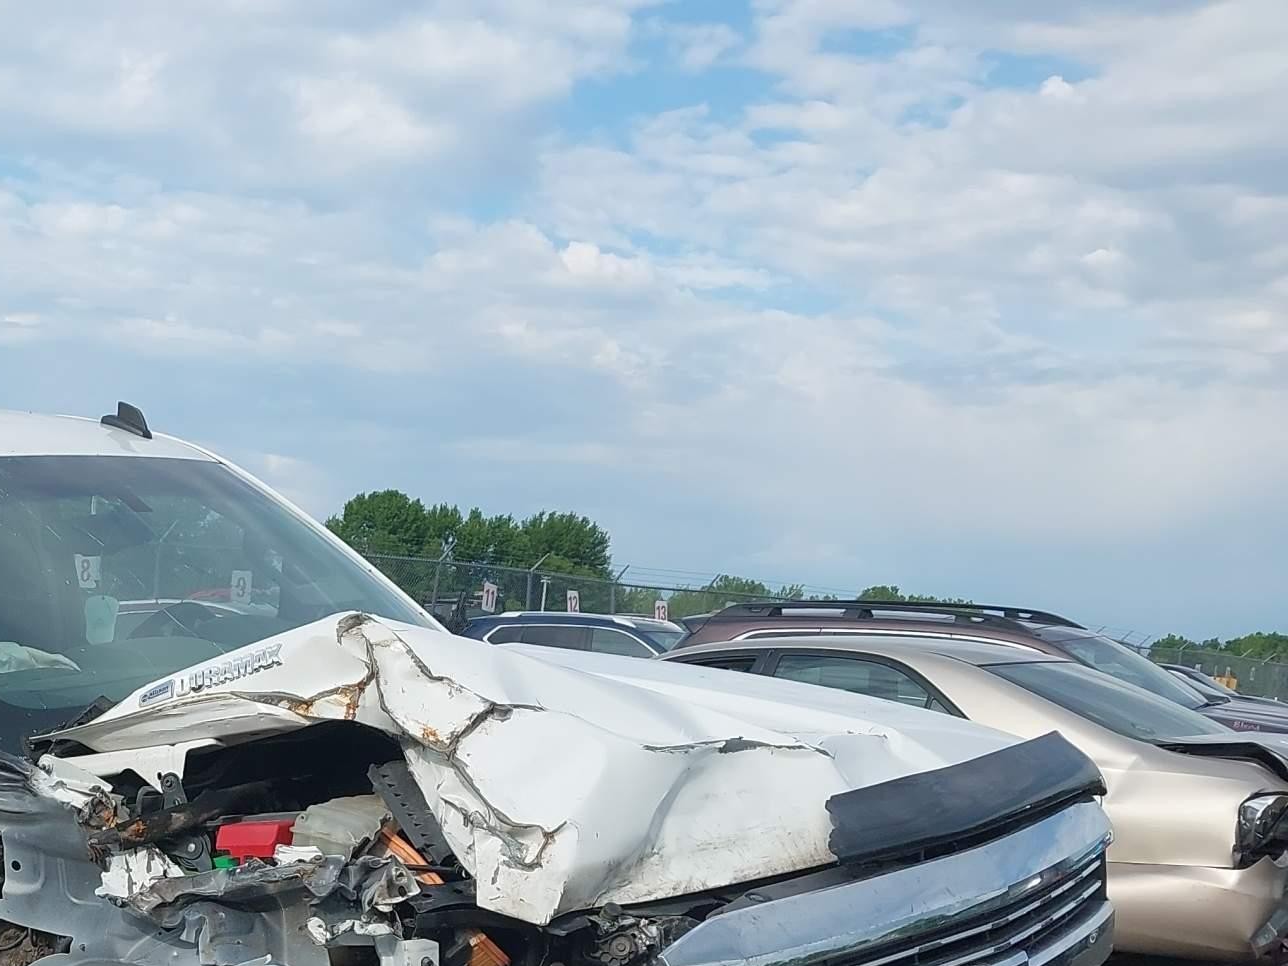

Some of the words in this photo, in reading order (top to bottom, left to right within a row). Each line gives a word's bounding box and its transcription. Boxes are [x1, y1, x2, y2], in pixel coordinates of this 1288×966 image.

[80, 558, 90, 582] 8
[483, 587, 496, 609] 11
[568, 595, 579, 613] 12
[655, 605, 667, 621] 13
[176, 643, 282, 697] DURAMAX
